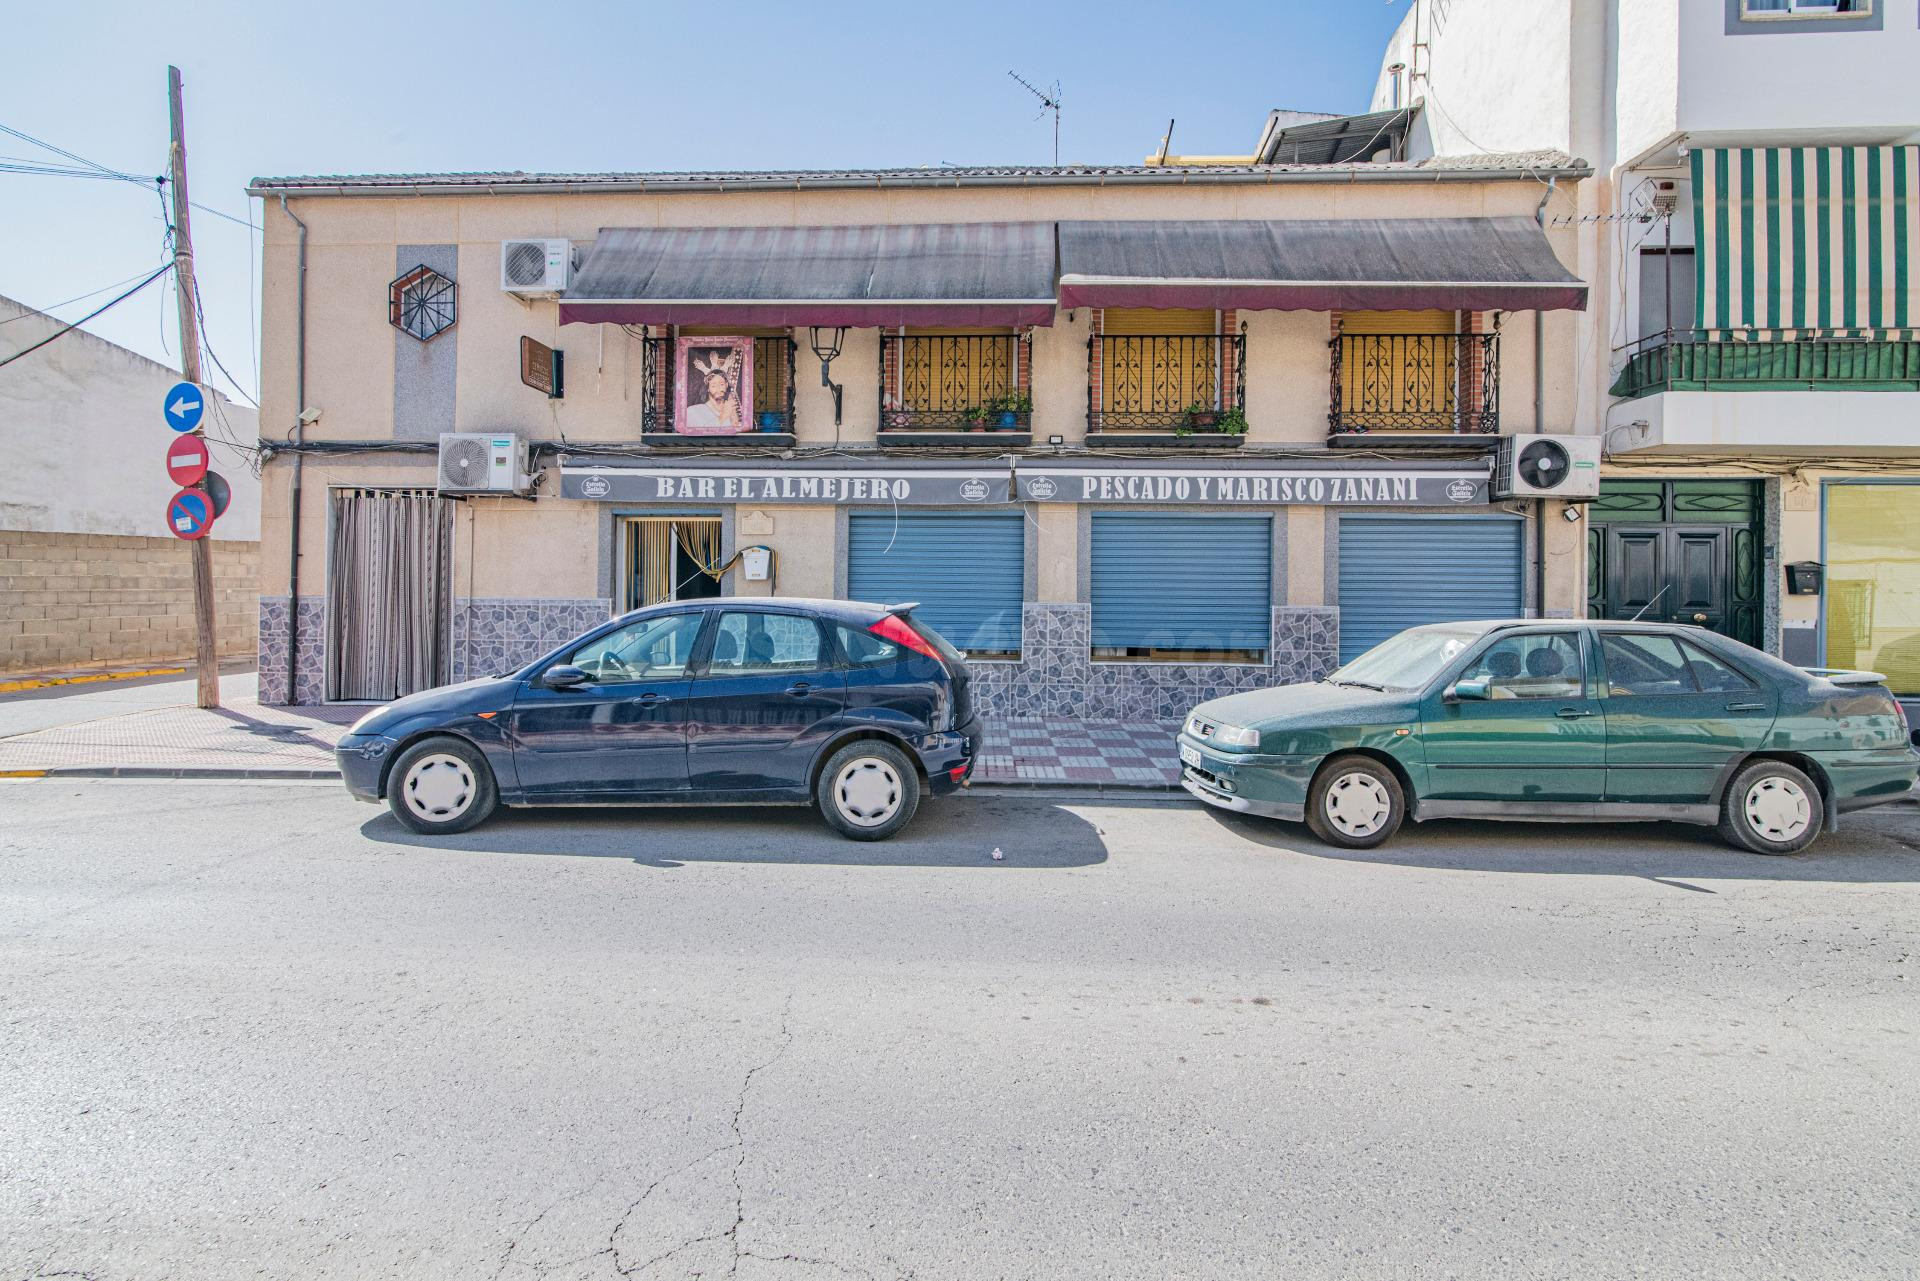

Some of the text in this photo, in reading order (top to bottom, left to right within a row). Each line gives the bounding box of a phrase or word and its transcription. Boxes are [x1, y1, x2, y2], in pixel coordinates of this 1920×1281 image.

[656, 477, 911, 501] BAR EL ALMEJERO
[1082, 476, 1419, 502] PESCADO Y MARISCO ZANANI
